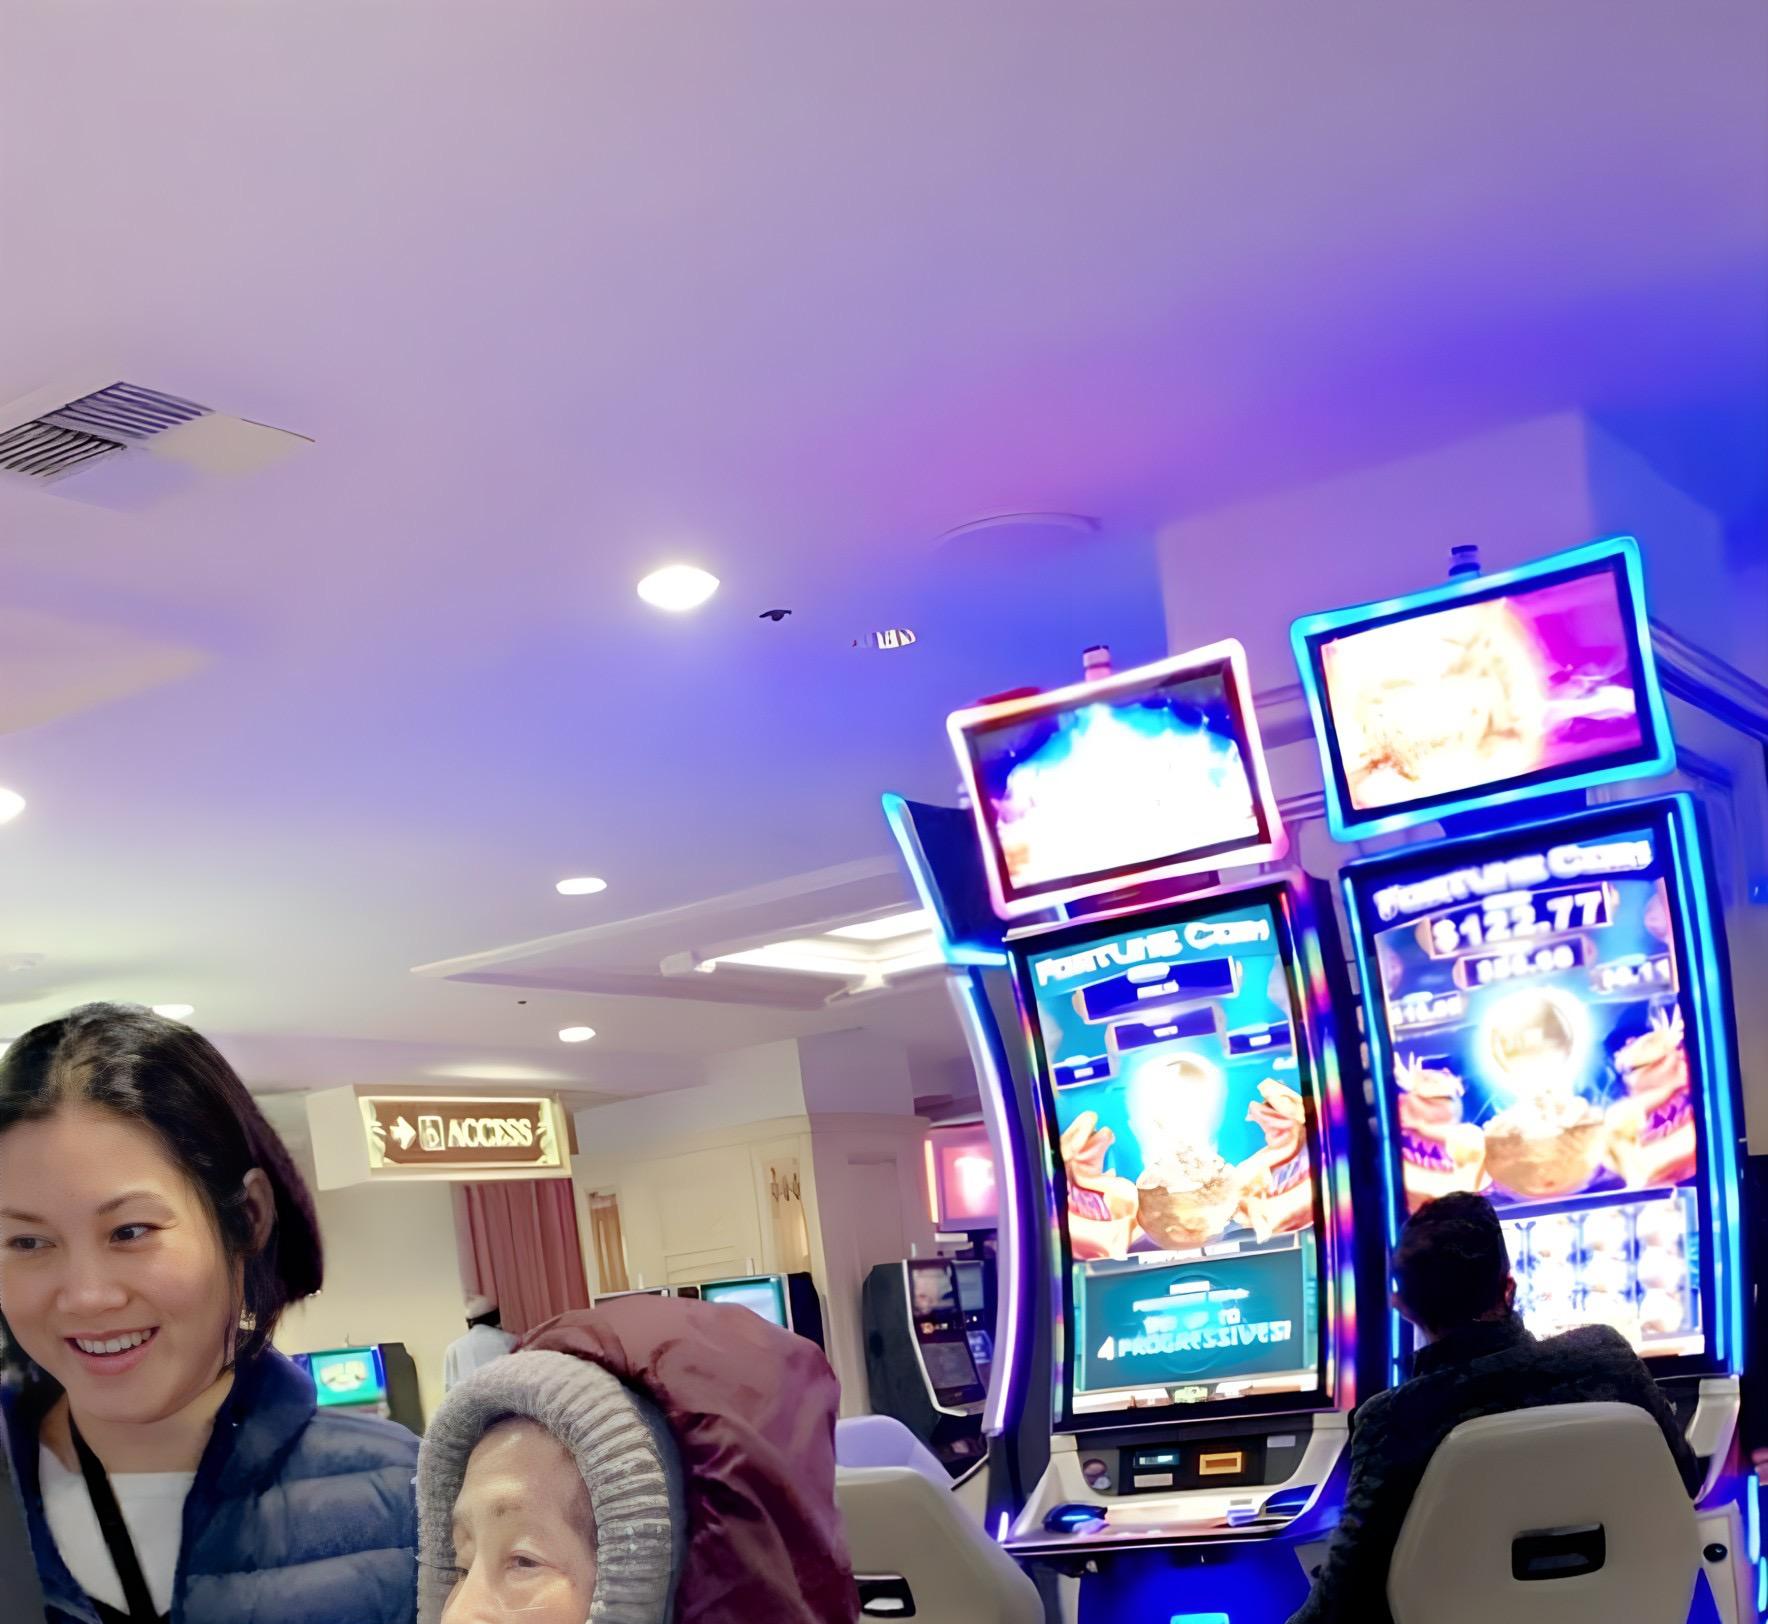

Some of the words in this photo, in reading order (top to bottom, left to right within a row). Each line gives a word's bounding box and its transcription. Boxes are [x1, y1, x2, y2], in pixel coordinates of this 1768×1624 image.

[1432, 890, 1603, 953] $122.77
[448, 1117, 533, 1147] ACCESS
[1097, 1336, 1114, 1360] 4
